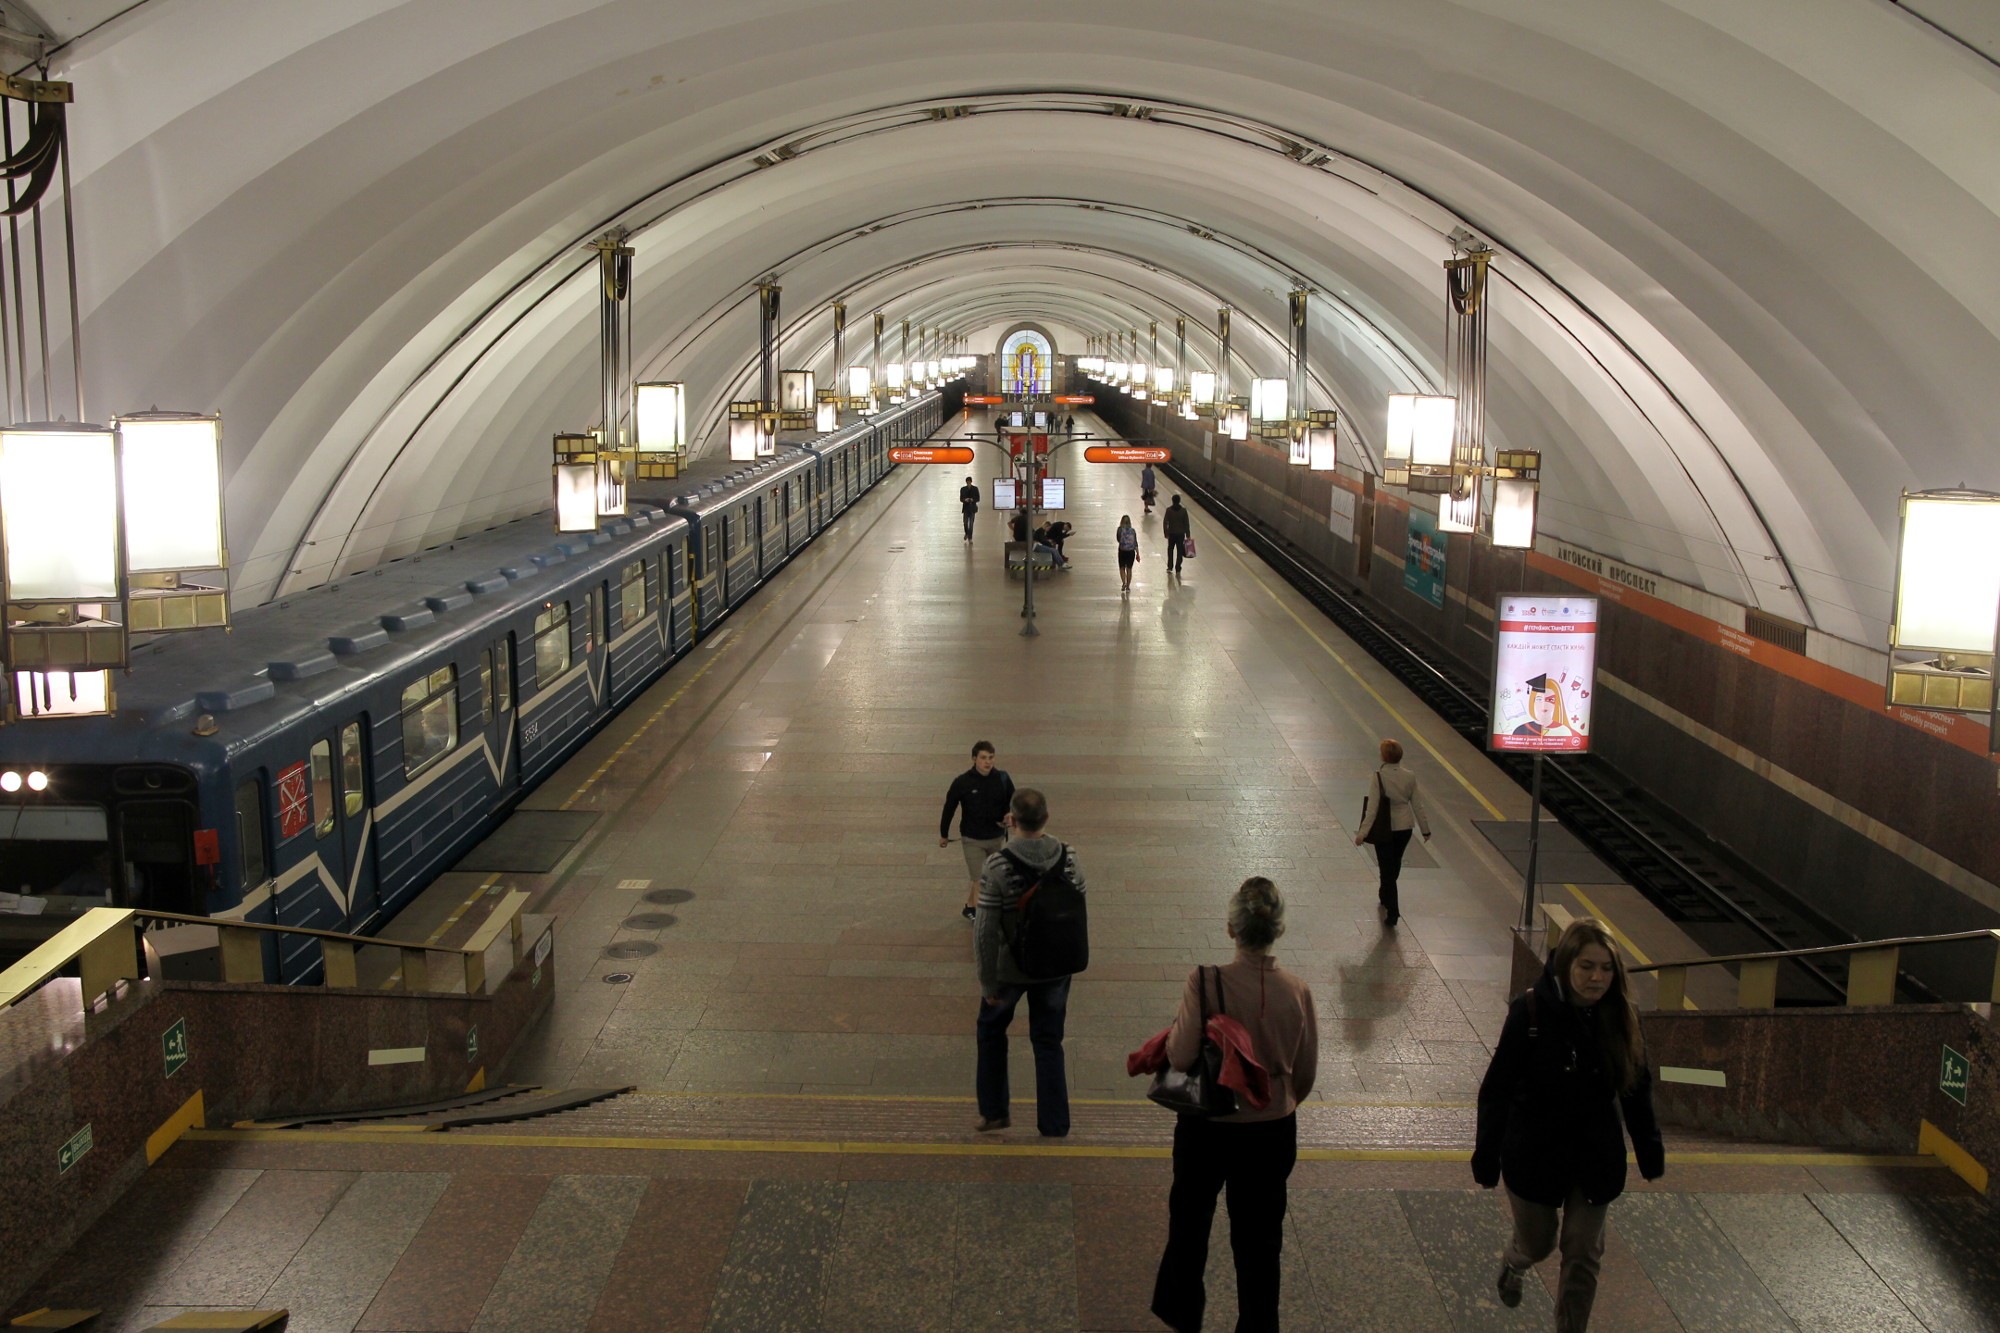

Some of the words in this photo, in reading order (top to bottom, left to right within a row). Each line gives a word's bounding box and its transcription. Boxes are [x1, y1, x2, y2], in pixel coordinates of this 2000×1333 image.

[1557, 546, 1603, 575] ЛИГОВСКИЙ
[1610, 566, 1656, 595] ПРОСПЕКТ
[1923, 720, 1948, 736] prospekt
